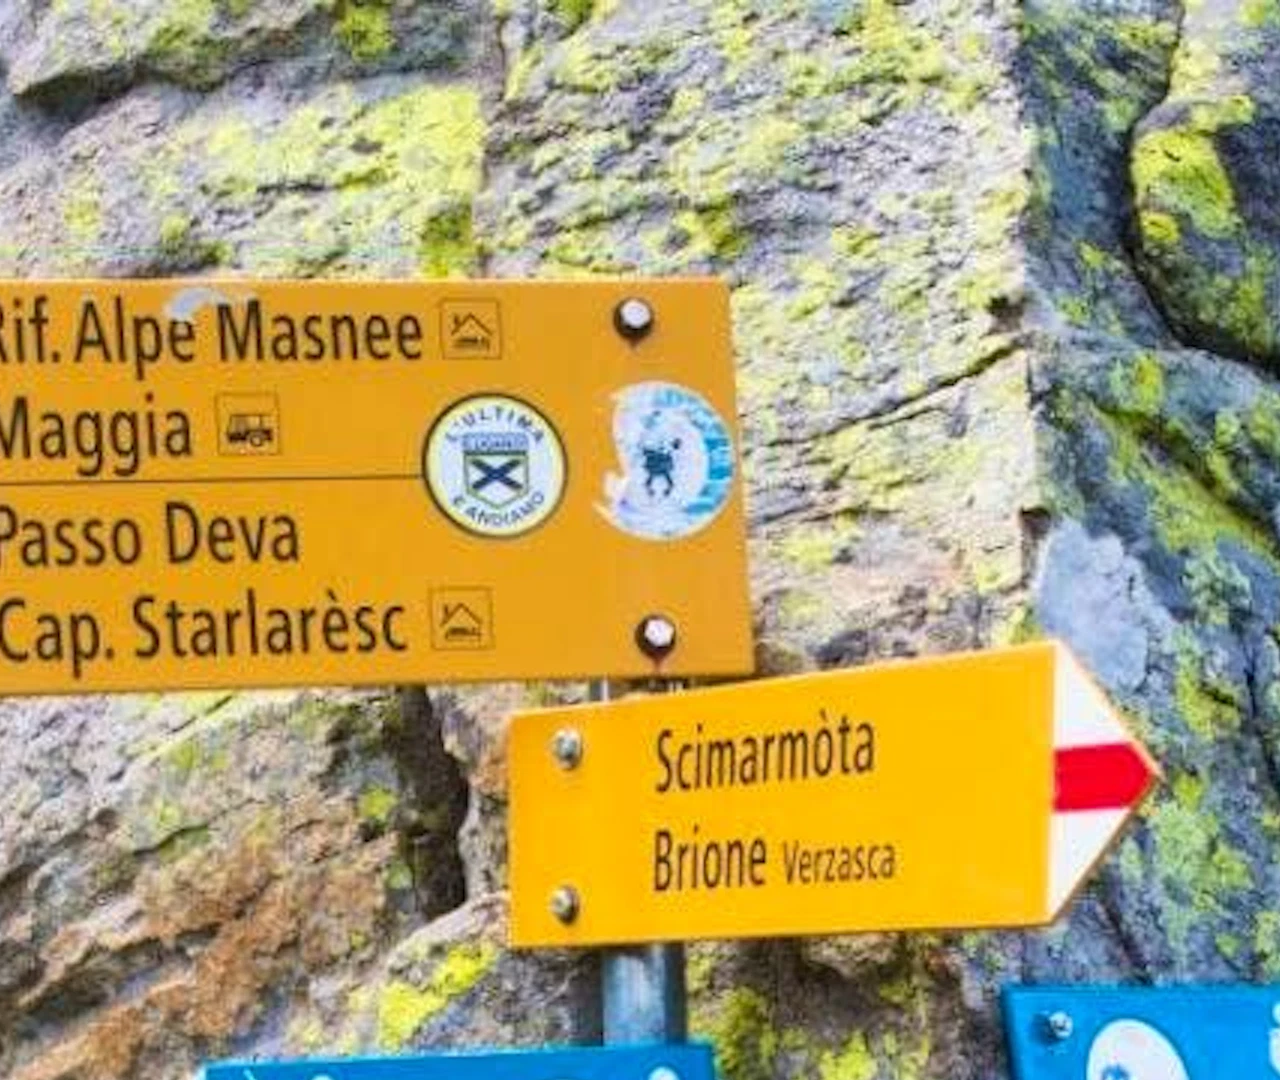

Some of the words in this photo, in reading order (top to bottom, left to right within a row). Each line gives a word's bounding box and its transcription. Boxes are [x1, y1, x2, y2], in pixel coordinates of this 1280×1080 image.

[75, 296, 196, 381] Alpe
[217, 296, 423, 362] Masnee
[166, 501, 300, 565] Deva
[132, 588, 407, 660] Starlarèsc
[655, 707, 875, 794] Scimarmòta
[654, 824, 767, 892] Brione
[784, 841, 896, 885] Verzasca
